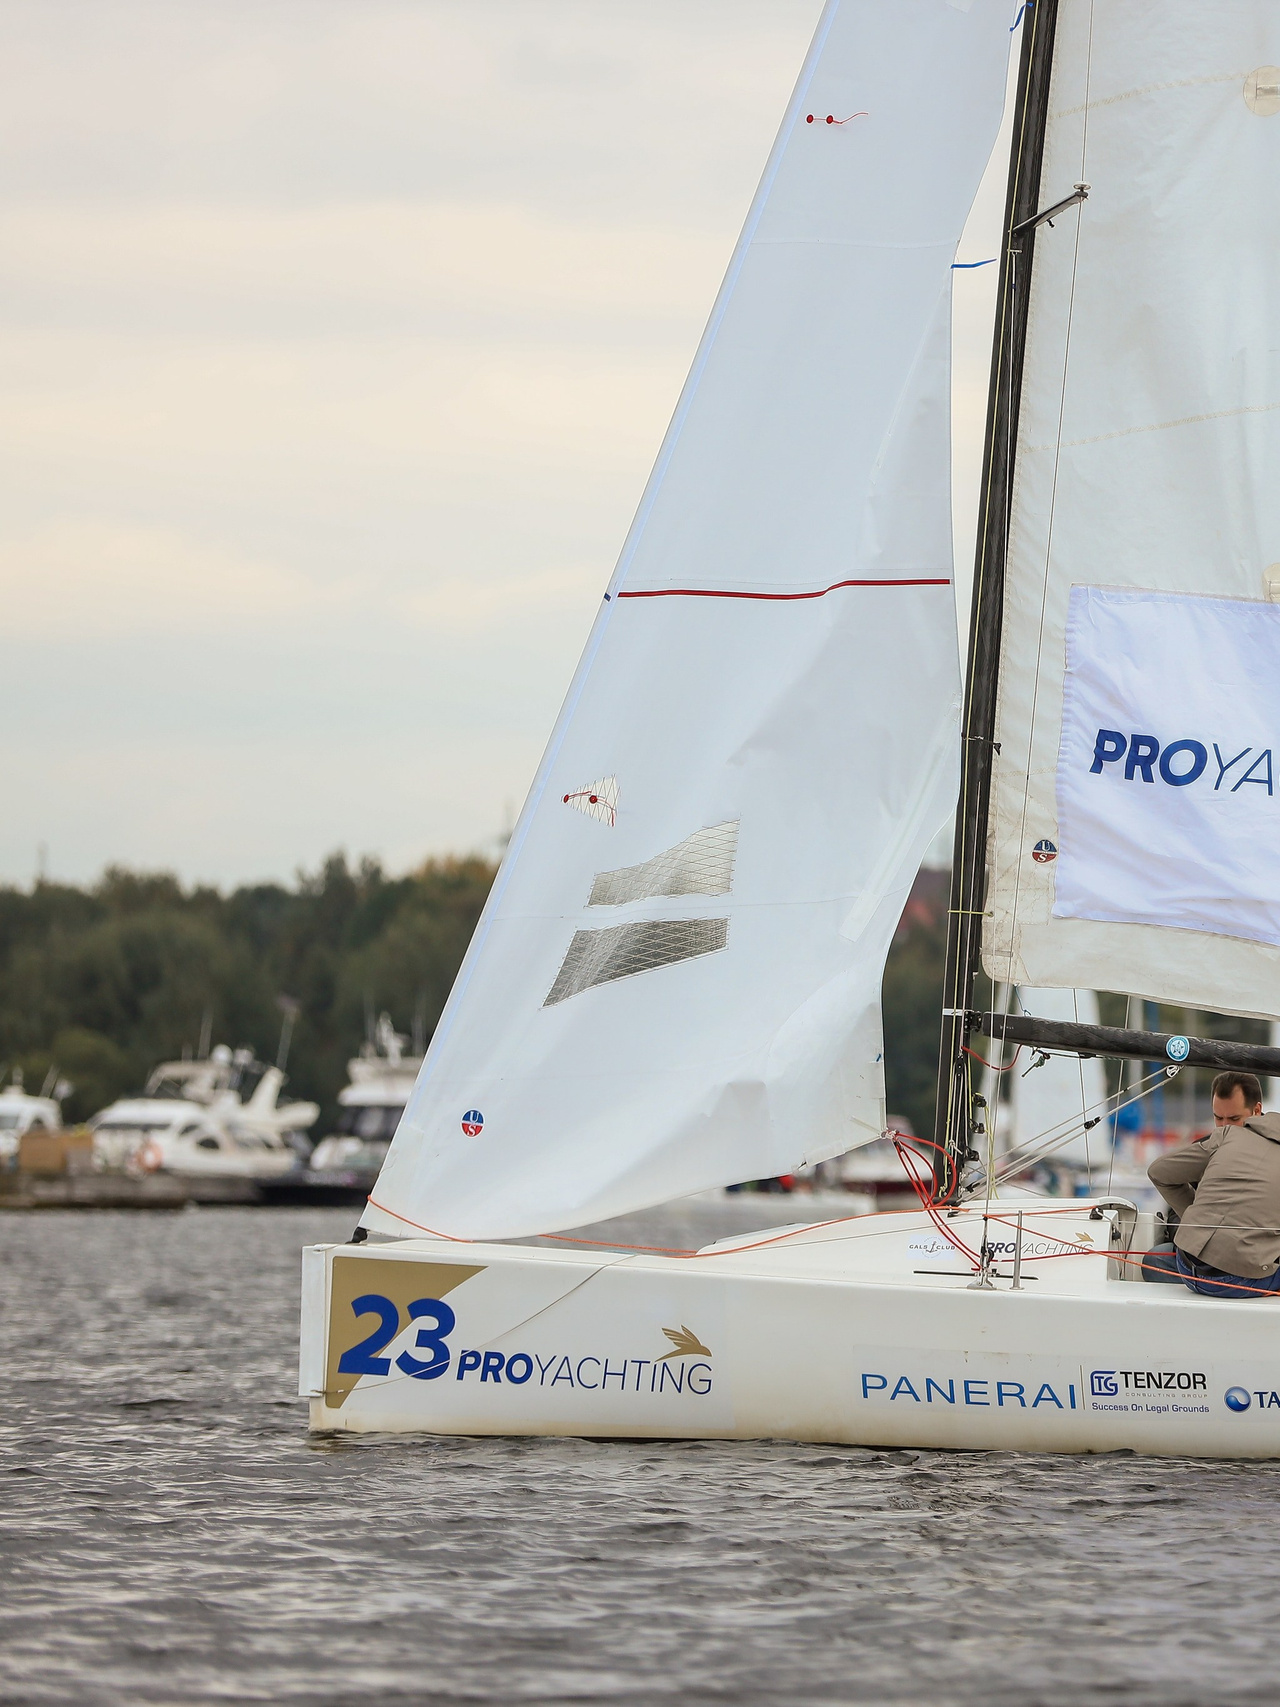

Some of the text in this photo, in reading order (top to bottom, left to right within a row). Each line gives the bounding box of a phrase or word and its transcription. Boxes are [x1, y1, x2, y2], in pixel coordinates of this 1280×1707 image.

[338, 1294, 456, 1380] 23
[456, 1350, 713, 1395] PROYACHTING
[1119, 1371, 1208, 1390] TENZOR
[861, 1373, 1077, 1410] PANERAI
[1091, 1402, 1210, 1414] Success On Legal Grounds
